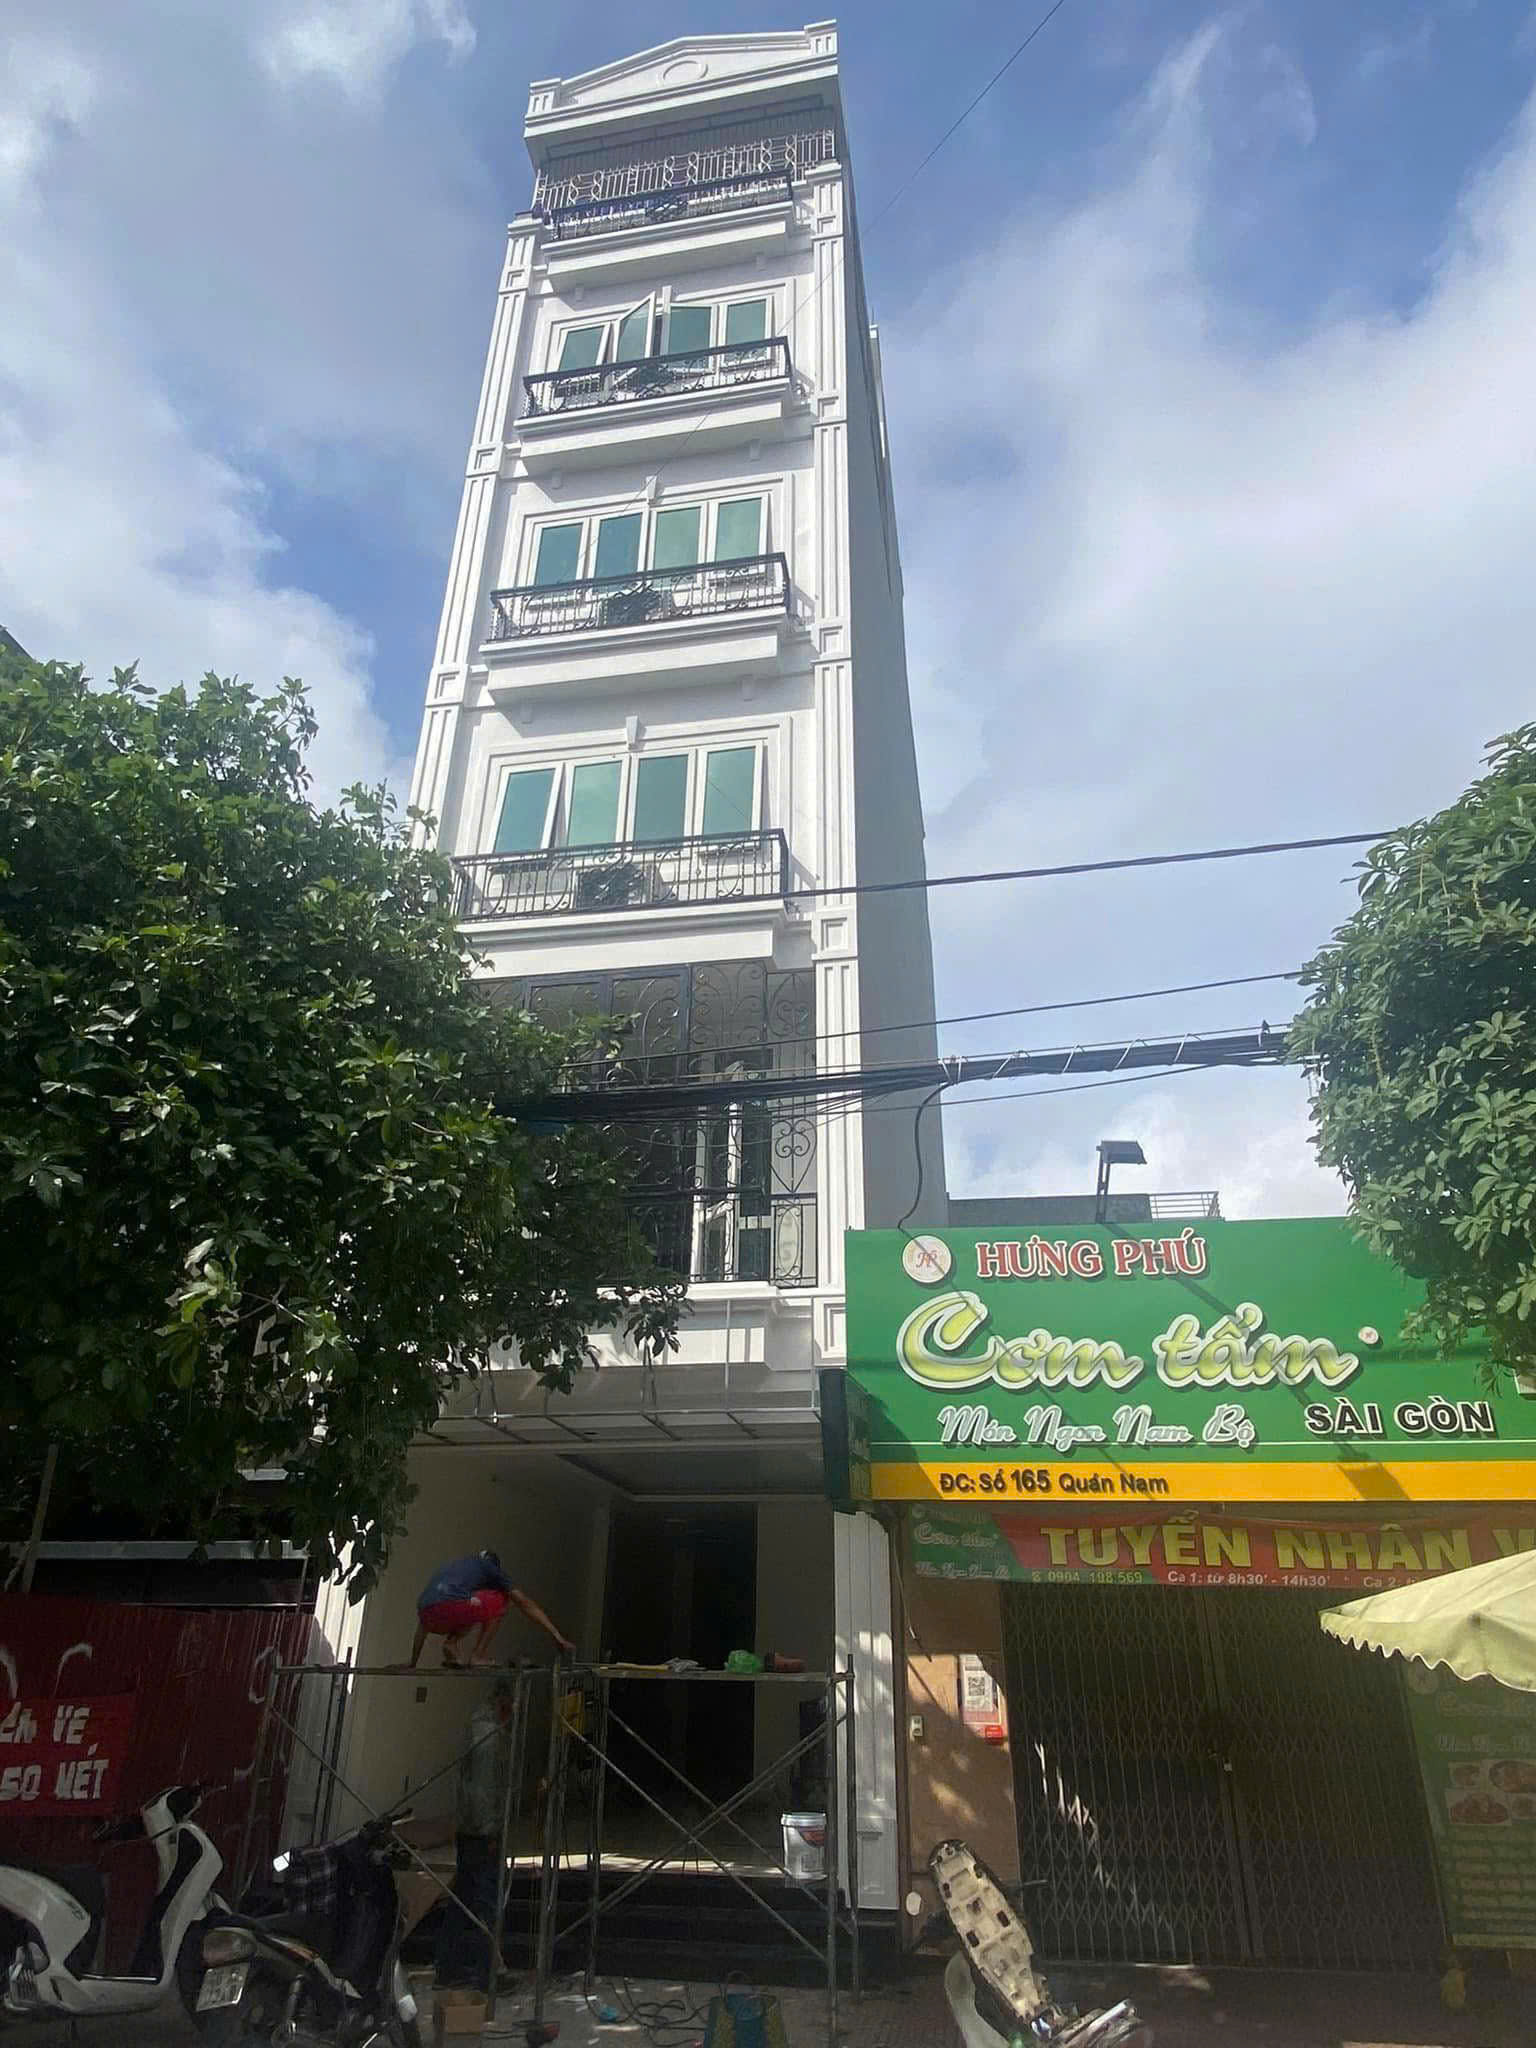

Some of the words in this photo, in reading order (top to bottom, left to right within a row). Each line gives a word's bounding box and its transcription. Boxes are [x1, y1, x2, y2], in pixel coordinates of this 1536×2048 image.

[976, 1236, 1102, 1278] HƯNG
[1113, 1228, 1207, 1276] PHÚ
[896, 1291, 1144, 1389] Cơm
[937, 1405, 1017, 1445] Món
[1024, 1404, 1106, 1452] Ngon
[1112, 1404, 1194, 1446] Nam
[1203, 1402, 1256, 1448] Bộ
[1305, 1395, 1382, 1434] SÀI
[1395, 1395, 1496, 1434] GÒN
[1010, 1469, 1051, 1493] 165
[1058, 1472, 1115, 1494] Quán
[1120, 1473, 1170, 1494] Nam
[1041, 1508, 1256, 1569] TUYỂN
[1273, 1523, 1472, 1571] NHÂN
